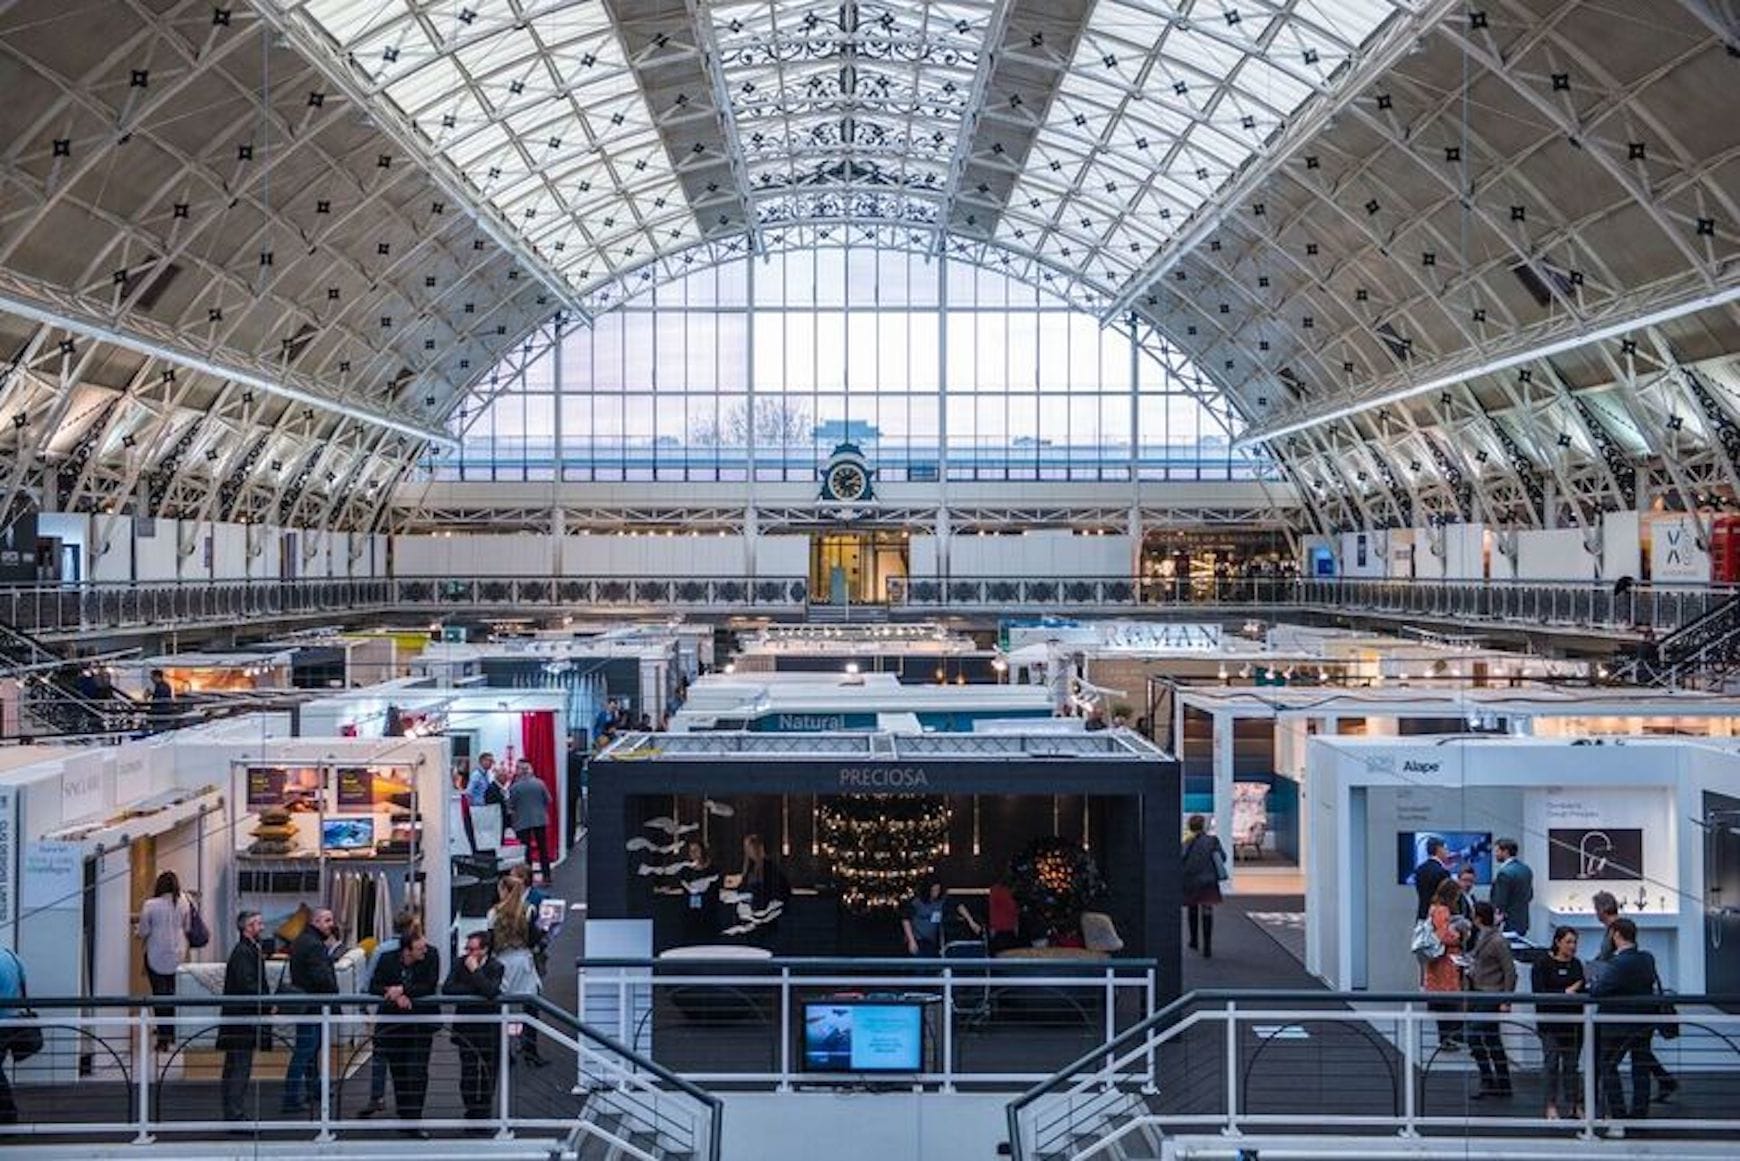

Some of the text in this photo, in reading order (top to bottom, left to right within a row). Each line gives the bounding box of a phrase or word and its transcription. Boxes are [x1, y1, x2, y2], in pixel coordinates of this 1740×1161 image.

[1104, 624, 1218, 647] ROMAN
[779, 714, 845, 730] Natural
[1403, 759, 1440, 774] Alape
[839, 768, 928, 787] PRECIOSA
